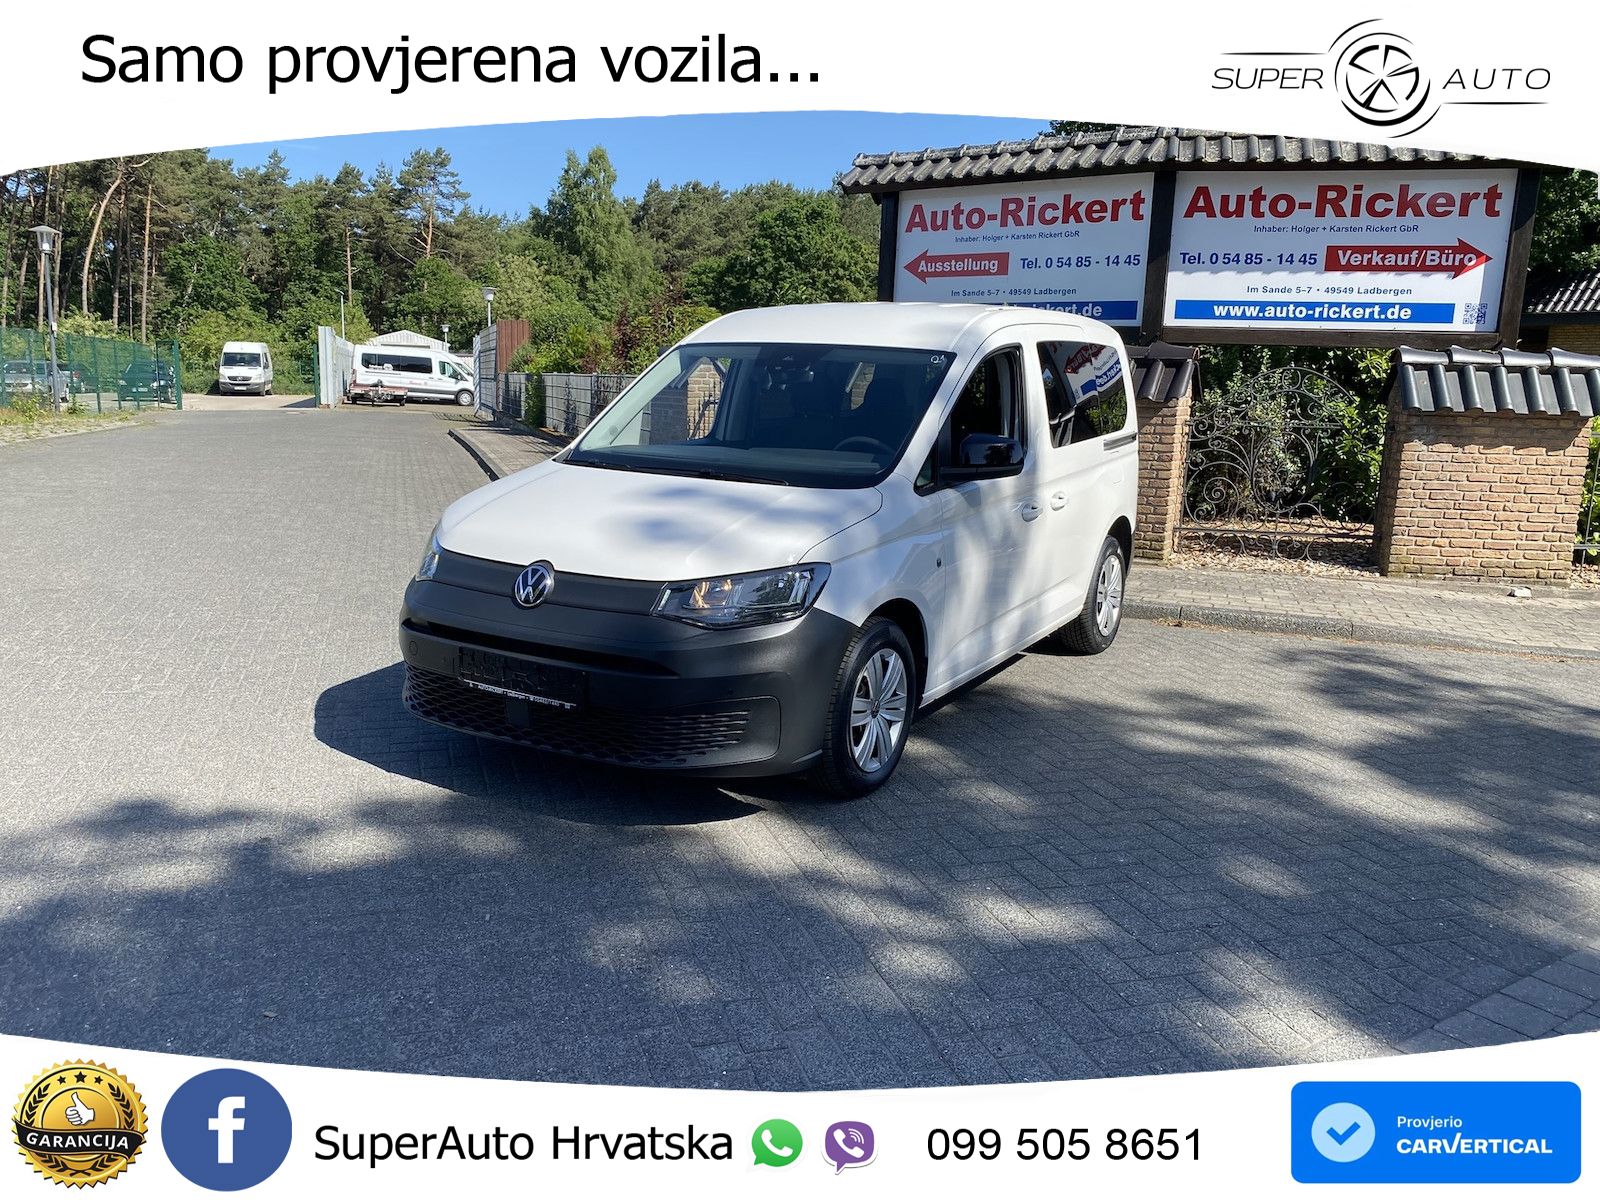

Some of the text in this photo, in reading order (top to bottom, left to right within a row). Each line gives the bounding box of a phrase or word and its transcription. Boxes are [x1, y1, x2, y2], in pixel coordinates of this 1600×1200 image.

[1182, 183, 1503, 219] Auto-Rickert
[905, 189, 1145, 233] Auto-Rickert
[954, 235, 981, 243] Inhaber:
[982, 234, 1004, 243] Holger
[1011, 233, 1037, 241] Karsten
[1038, 231, 1063, 239] Rickert
[1064, 230, 1080, 238] GbR
[1253, 225, 1289, 233] Inhaber:
[1291, 225, 1320, 234] Holger
[1329, 225, 1363, 233] Karsten
[1365, 225, 1397, 233] Rickert
[1399, 225, 1419, 233] GbR
[917, 257, 999, 273] Ausstellung
[1020, 257, 1042, 269] Tel.
[1045, 257, 1053, 269] 0
[1056, 256, 1073, 268] 54
[1075, 256, 1092, 268] 85
[1105, 255, 1120, 267] 14
[1124, 254, 1141, 266] 45
[1179, 252, 1206, 265] Tel.
[1209, 252, 1219, 265] 0
[1222, 252, 1241, 265] 54
[1244, 252, 1264, 265] 85
[1277, 252, 1295, 265] 14
[1298, 253, 1318, 265] 45
[1337, 249, 1477, 268] Verkauf/Büro
[962, 289, 985, 297] Sande
[1008, 288, 1032, 296] 49549
[1033, 287, 1077, 296] Ladbergen
[1246, 286, 1259, 294] Im
[1262, 286, 1293, 294] Sande
[1324, 286, 1354, 295] 49549
[1356, 286, 1413, 297] Ladbergen
[1213, 303, 1412, 320] www.auto-rickert.de
